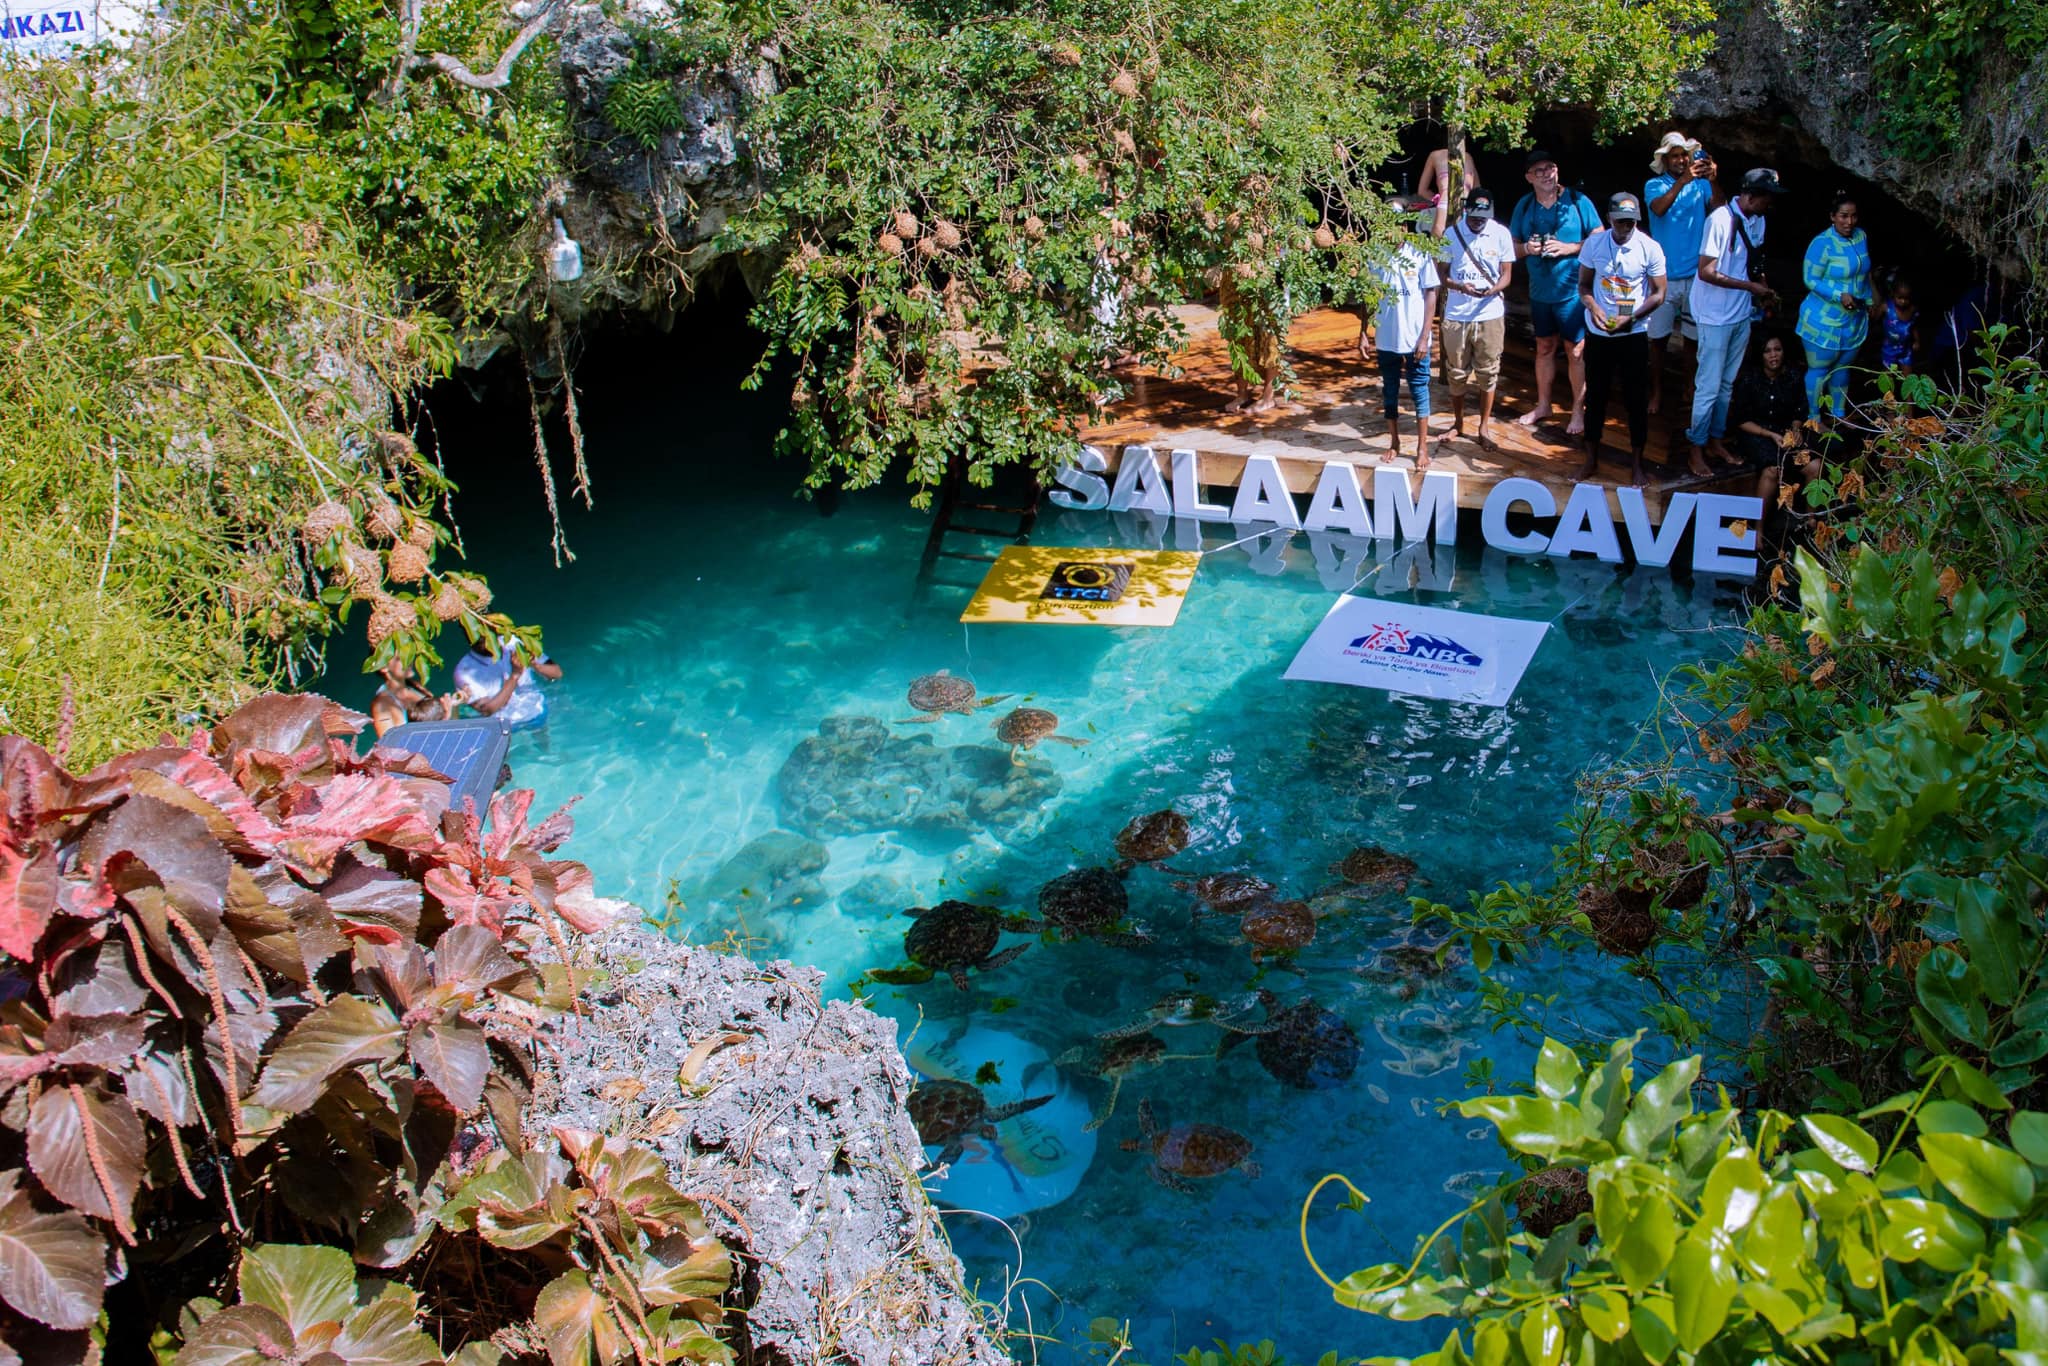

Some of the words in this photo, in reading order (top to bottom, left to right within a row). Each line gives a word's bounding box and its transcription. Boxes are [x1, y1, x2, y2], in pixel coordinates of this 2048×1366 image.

[1050, 446, 1458, 545] SALAAM
[1481, 477, 1763, 576] CAVE
[1413, 645, 1475, 665] NBC
